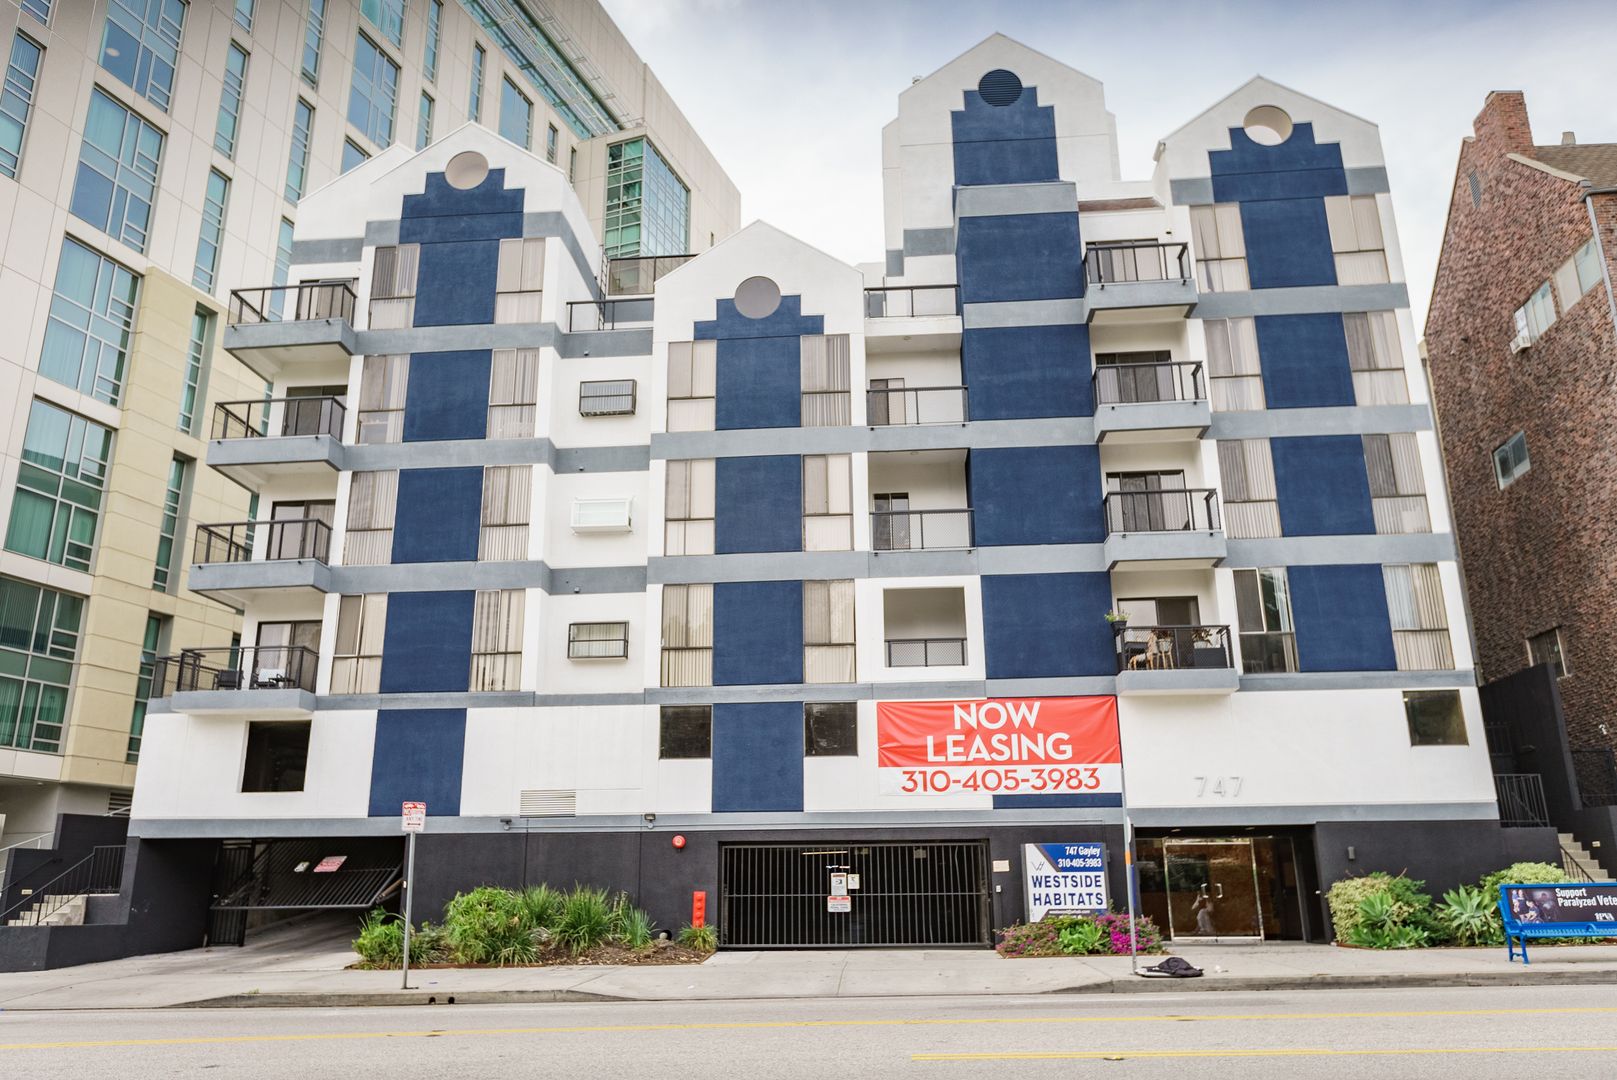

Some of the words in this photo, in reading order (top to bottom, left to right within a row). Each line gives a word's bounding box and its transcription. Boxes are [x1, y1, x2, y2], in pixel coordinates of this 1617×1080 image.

[953, 701, 1041, 730] NOW
[926, 732, 1073, 763] LEASING
[901, 768, 1101, 793] 310-405-3983
[1193, 776, 1244, 797] 747
[1065, 846, 1077, 855] 747
[1078, 846, 1101, 857] Gayley
[1057, 858, 1102, 868] 310-405-3983
[1031, 875, 1102, 888] WESTSIDE
[1033, 892, 1104, 906] HABITATS
[1555, 887, 1587, 898] Support
[1557, 897, 1597, 908] Paralyzed
